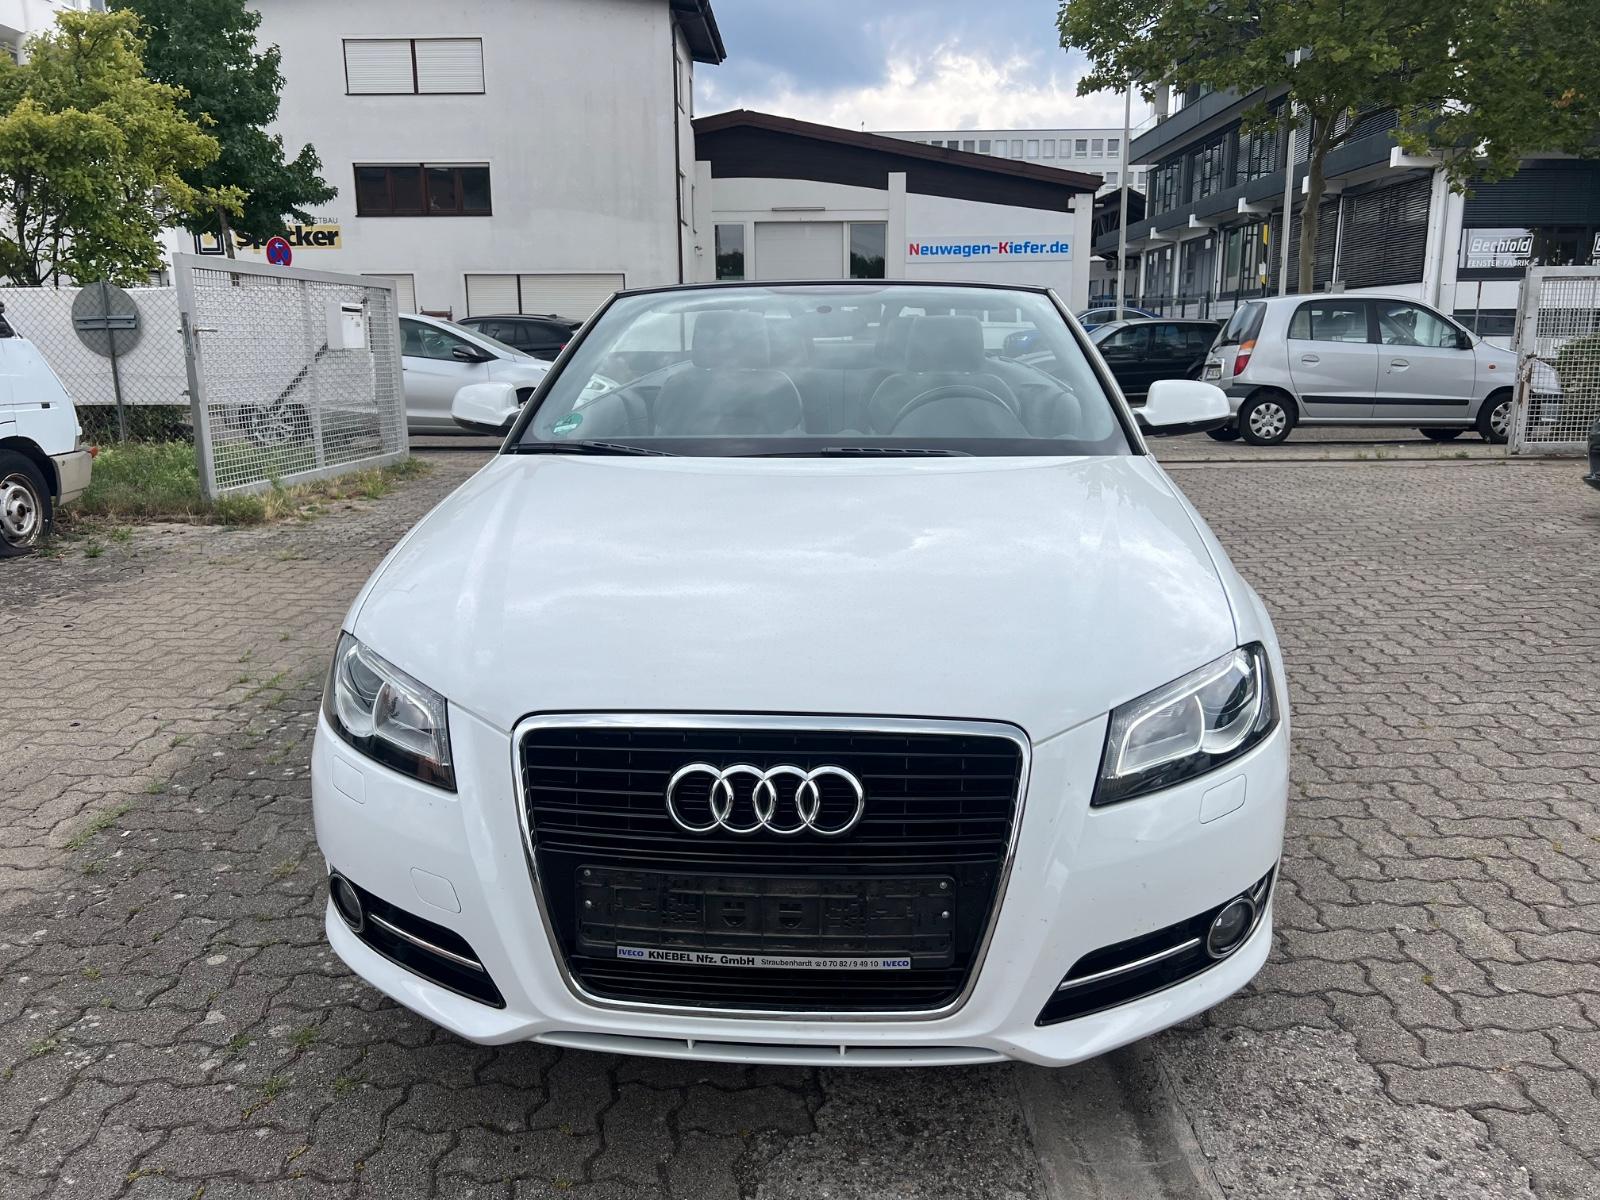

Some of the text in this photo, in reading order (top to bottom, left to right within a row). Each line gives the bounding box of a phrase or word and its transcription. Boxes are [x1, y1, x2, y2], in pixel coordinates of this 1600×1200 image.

[909, 241, 1069, 257] Neuwagen-Kiefer.de
[618, 948, 644, 957] IVECO
[648, 950, 693, 962] KNEBEL
[696, 954, 717, 964] Nfz.
[720, 955, 755, 966] GmbH
[761, 958, 813, 967] Straubenhardt
[829, 960, 838, 968] 70
[882, 960, 909, 968] IVECO
